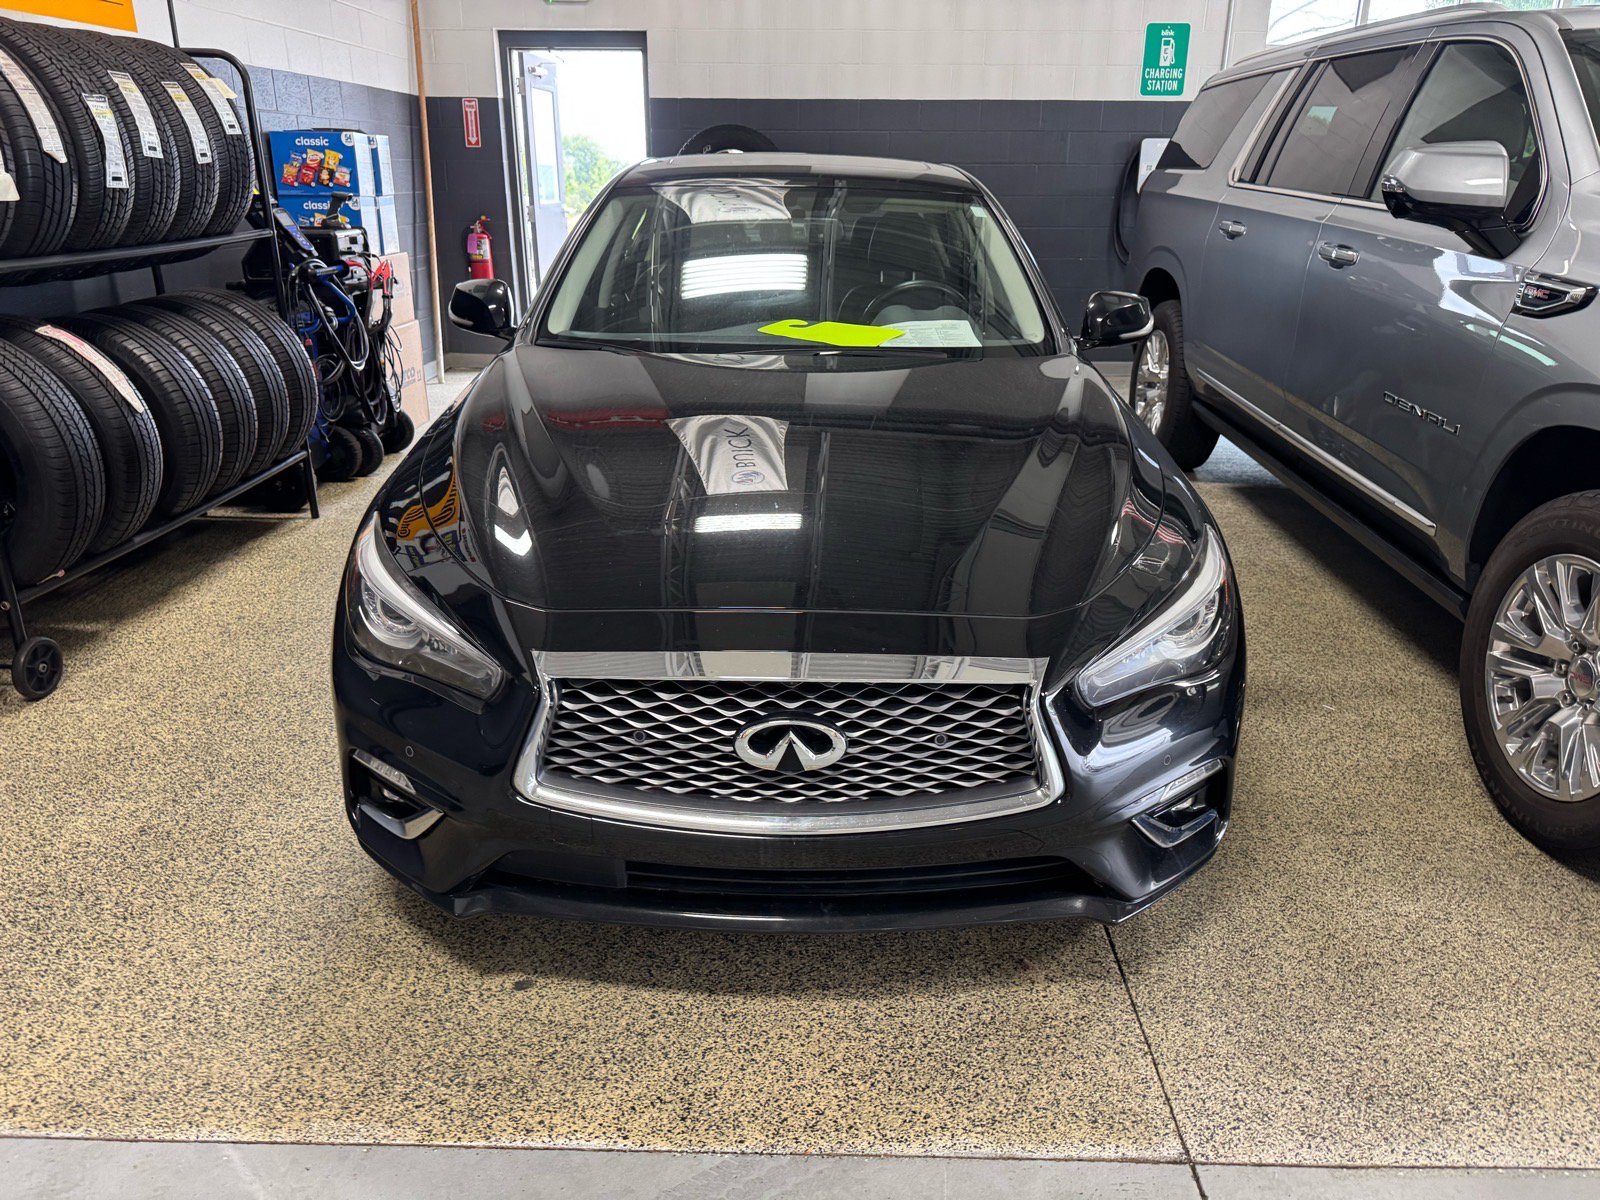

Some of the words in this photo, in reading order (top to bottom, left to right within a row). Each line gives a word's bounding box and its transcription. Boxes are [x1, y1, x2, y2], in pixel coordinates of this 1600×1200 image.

[1145, 67, 1183, 79] CHARGING
[1146, 80, 1178, 92] STATION
[295, 135, 329, 146] classic
[303, 200, 331, 210] classi
[1383, 391, 1461, 436] DENALI
